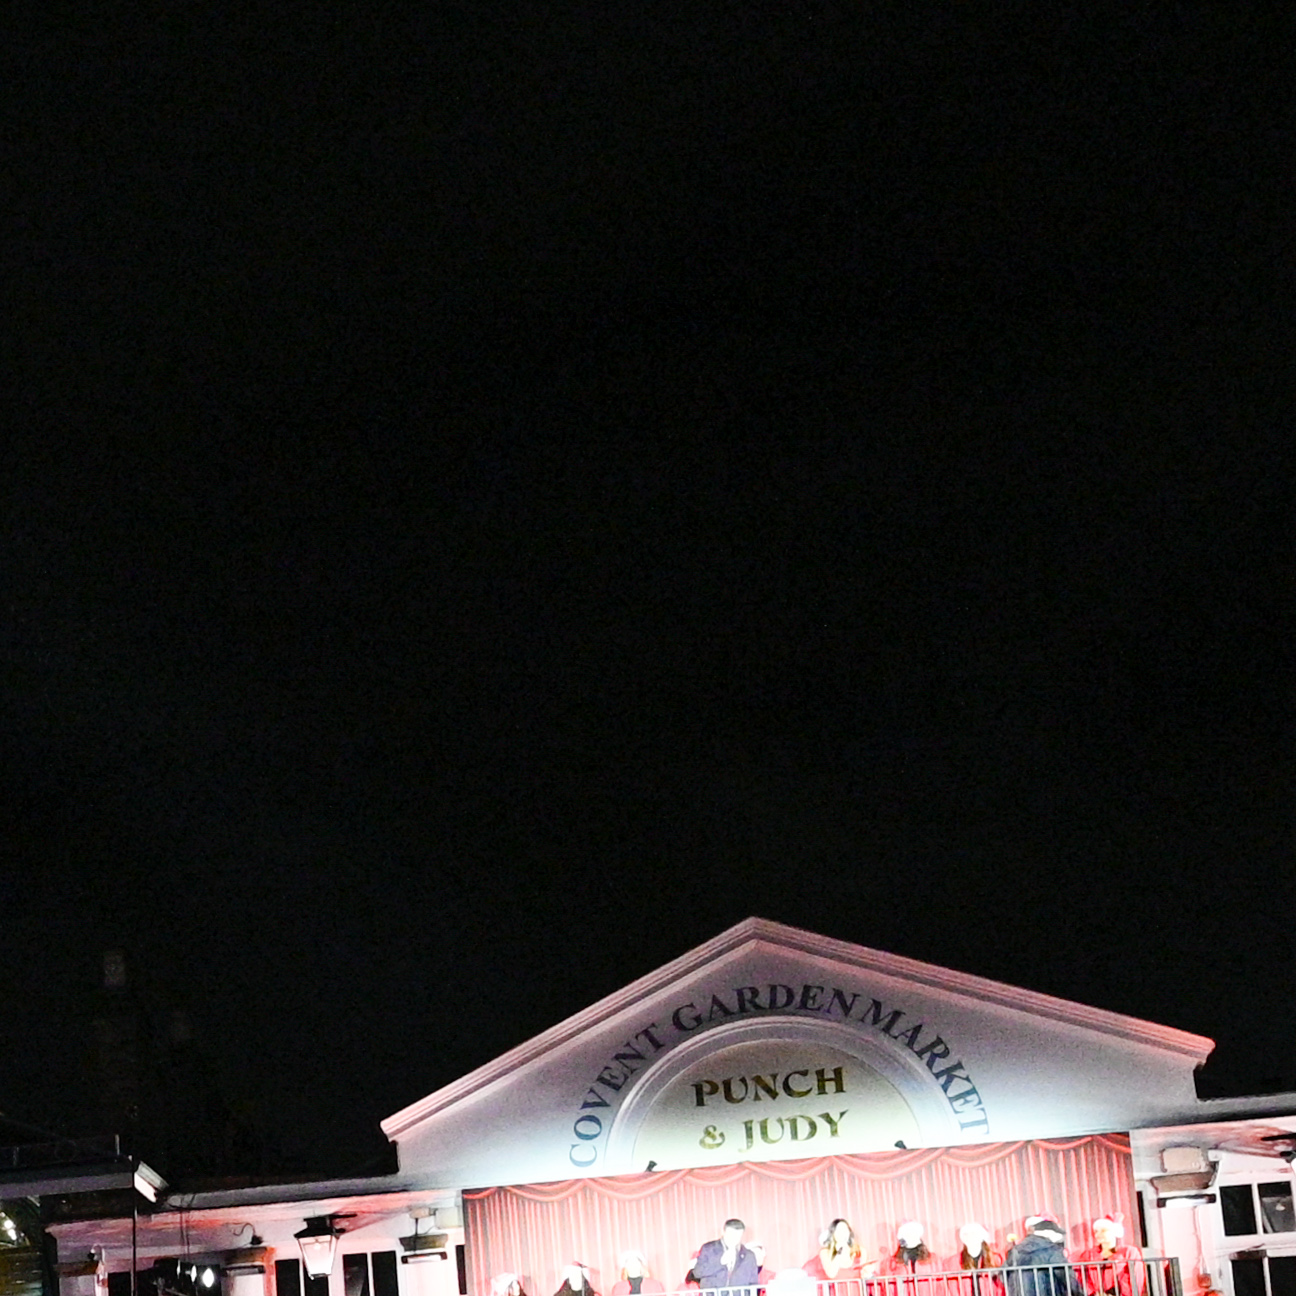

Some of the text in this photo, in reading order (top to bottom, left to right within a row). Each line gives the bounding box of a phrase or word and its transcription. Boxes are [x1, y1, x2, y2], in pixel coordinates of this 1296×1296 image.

[569, 984, 990, 1168] COVENT GARDEN MARKET
[690, 1065, 847, 1107] PUNCH
[698, 1108, 849, 1153] & JUDY
